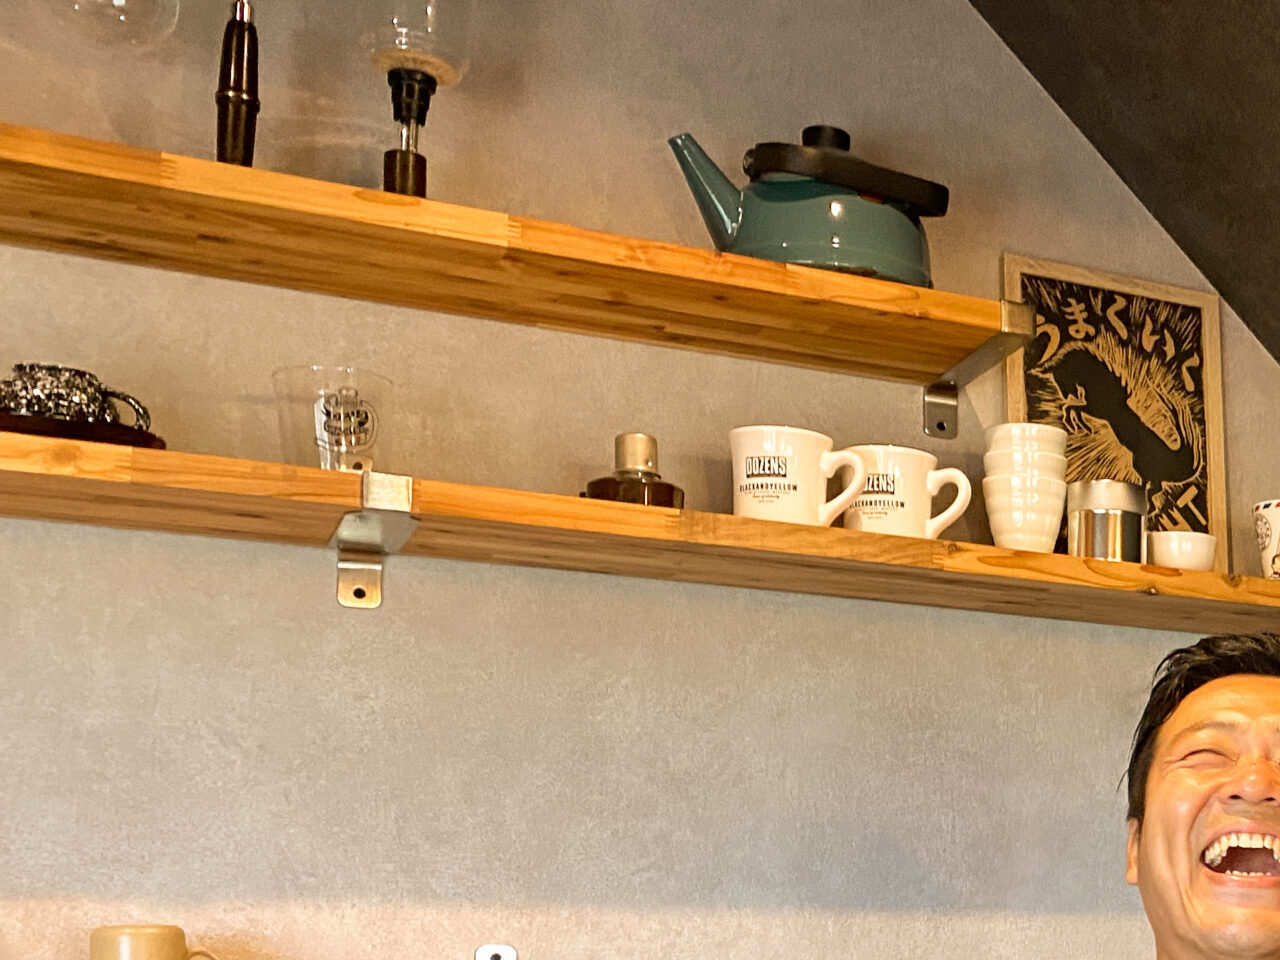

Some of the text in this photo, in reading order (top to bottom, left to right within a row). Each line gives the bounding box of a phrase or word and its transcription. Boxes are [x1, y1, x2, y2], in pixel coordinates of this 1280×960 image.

[1036, 294, 1200, 393] うまくいく
[746, 456, 787, 476] DOZENS
[862, 474, 895, 493] ZENS
